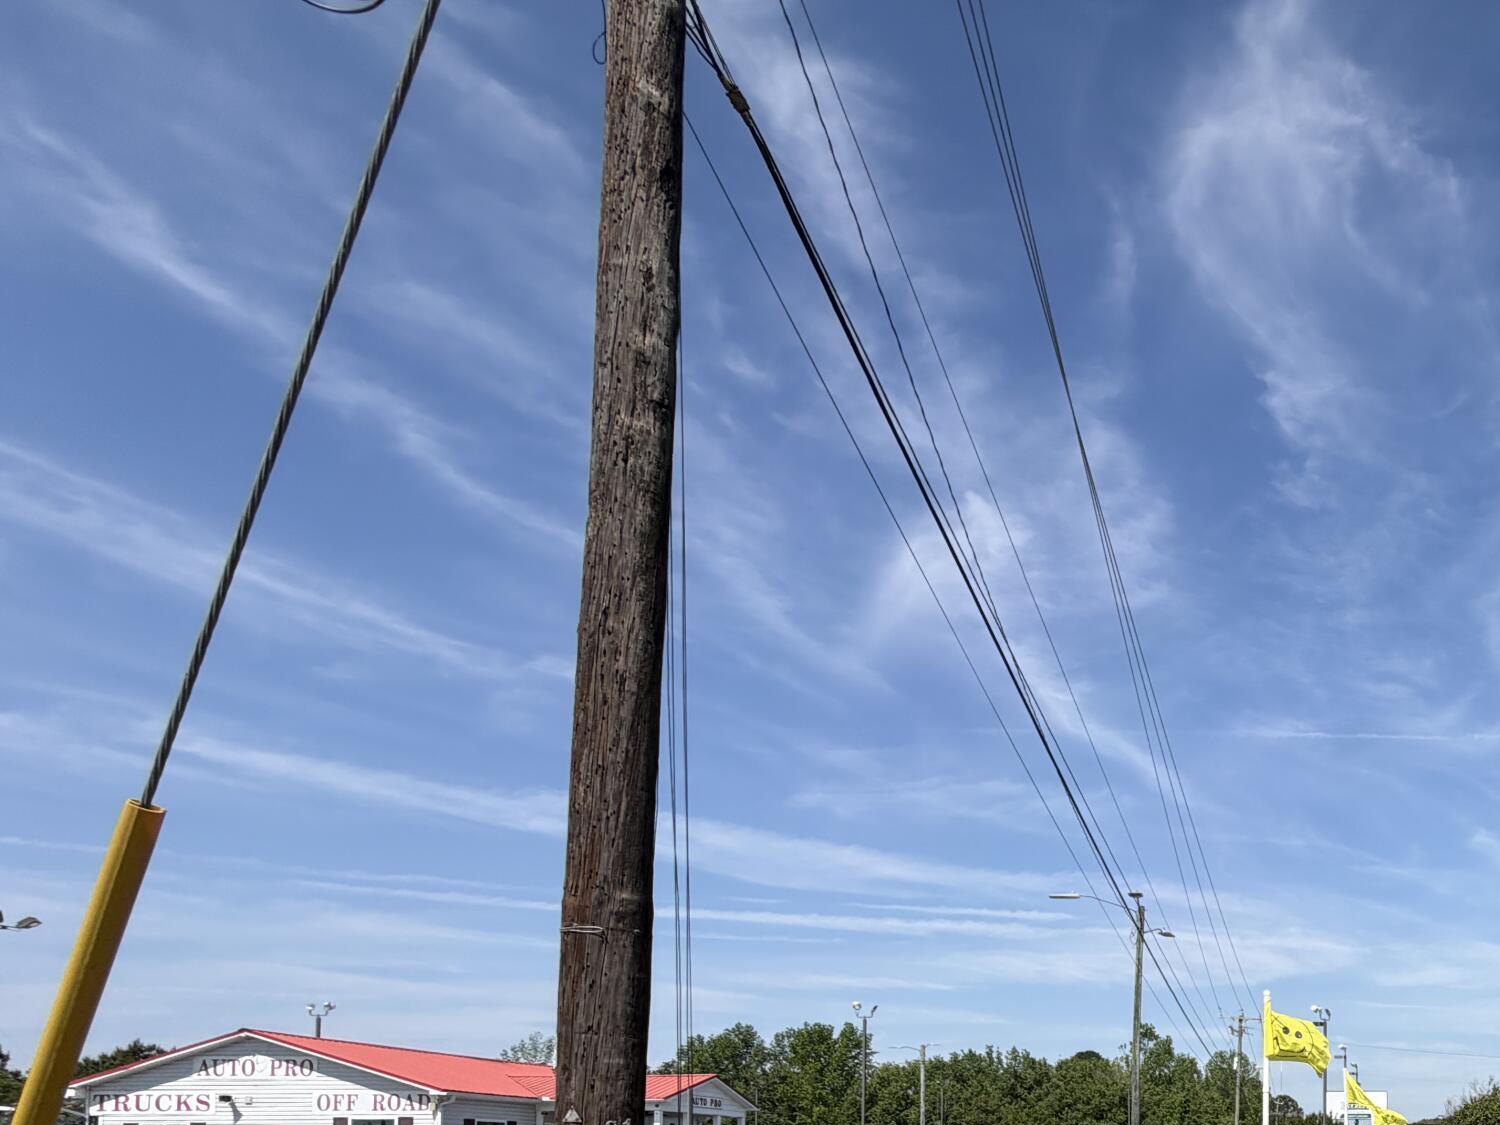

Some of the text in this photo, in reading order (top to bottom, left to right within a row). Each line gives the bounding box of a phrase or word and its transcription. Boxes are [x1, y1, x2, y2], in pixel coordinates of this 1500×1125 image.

[196, 1058, 315, 1078] AUTO PRO
[92, 1093, 212, 1113] TRUCKS
[316, 1093, 432, 1113] OFF ROAD
